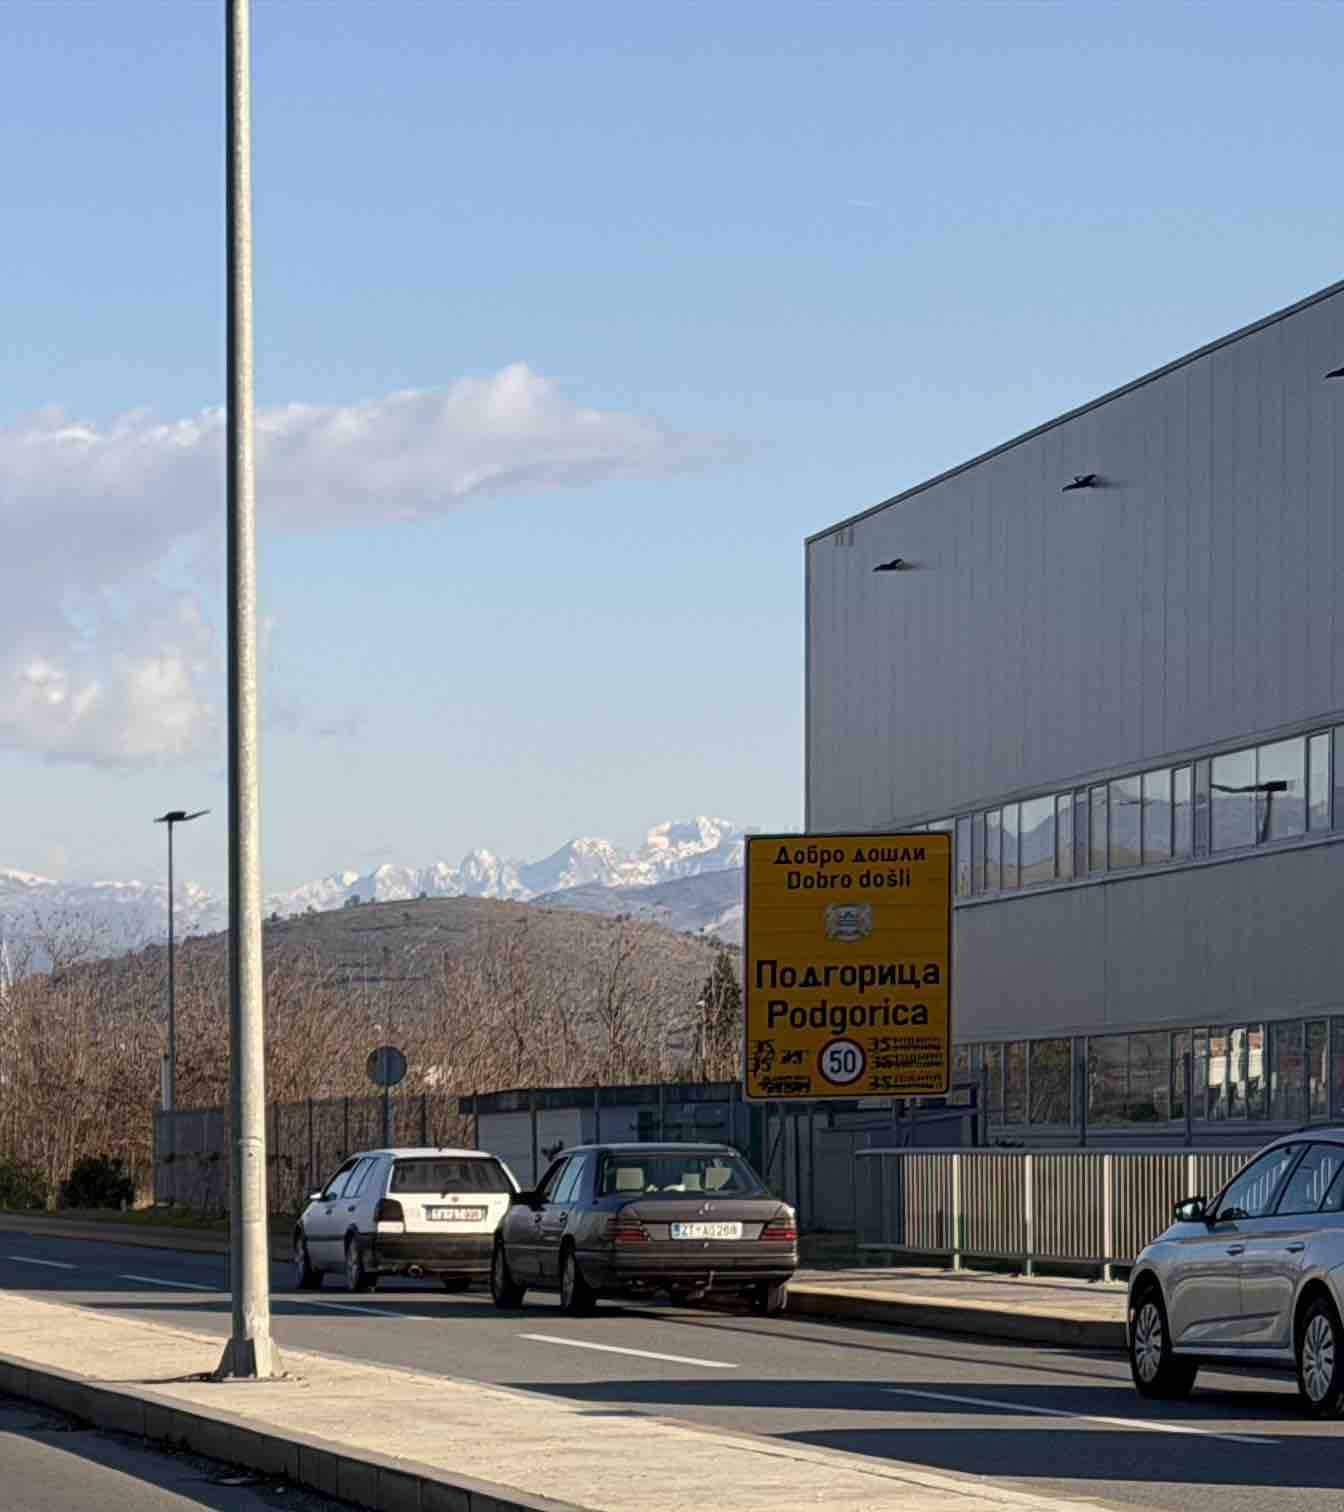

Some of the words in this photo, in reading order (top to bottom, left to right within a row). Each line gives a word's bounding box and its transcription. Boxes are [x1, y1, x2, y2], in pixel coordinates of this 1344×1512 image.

[773, 846, 844, 867] Добро
[852, 847, 925, 863] дошли
[787, 871, 852, 889] Dobro
[859, 869, 911, 888] došli
[756, 960, 940, 993] Подгорица
[767, 998, 928, 1034] Podgorica
[829, 1050, 856, 1074] 50
